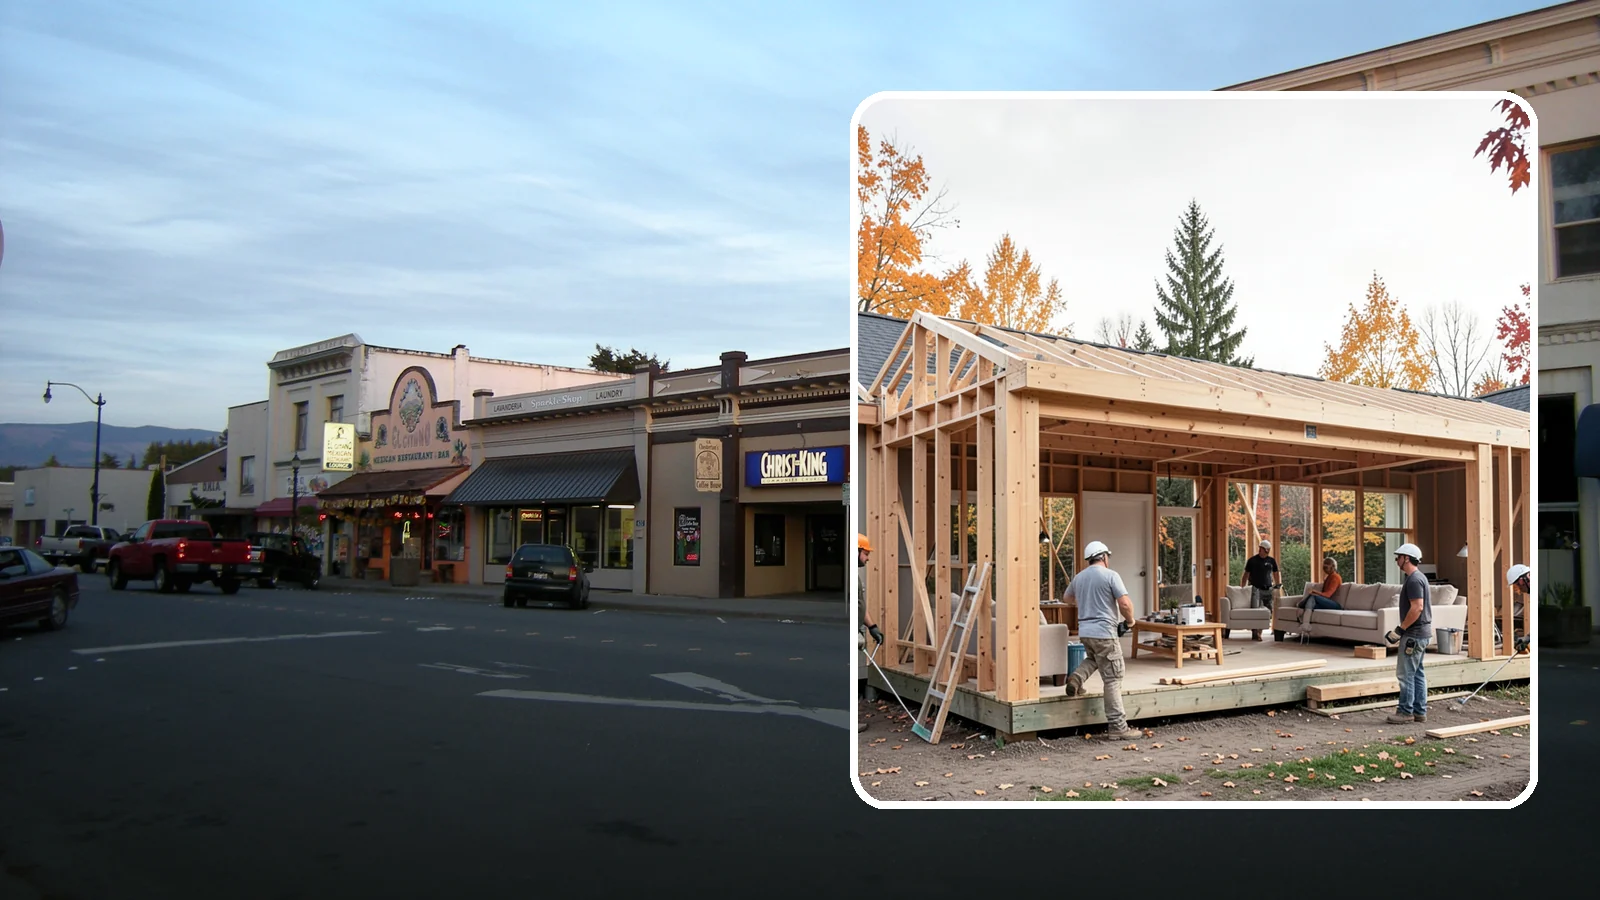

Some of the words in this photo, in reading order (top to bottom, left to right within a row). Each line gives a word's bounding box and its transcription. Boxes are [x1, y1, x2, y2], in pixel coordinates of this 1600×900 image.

[531, 399, 560, 408] Sparkle
[562, 394, 582, 404] Shop
[595, 389, 623, 400] LAUNDRY
[493, 403, 522, 412] LAVANDERIA
[374, 455, 395, 463] MEXICAN
[397, 452, 433, 462] RESTAURANT
[438, 450, 450, 459] BAR
[761, 452, 797, 478] CHRIST
[799, 450, 827, 476] KING
